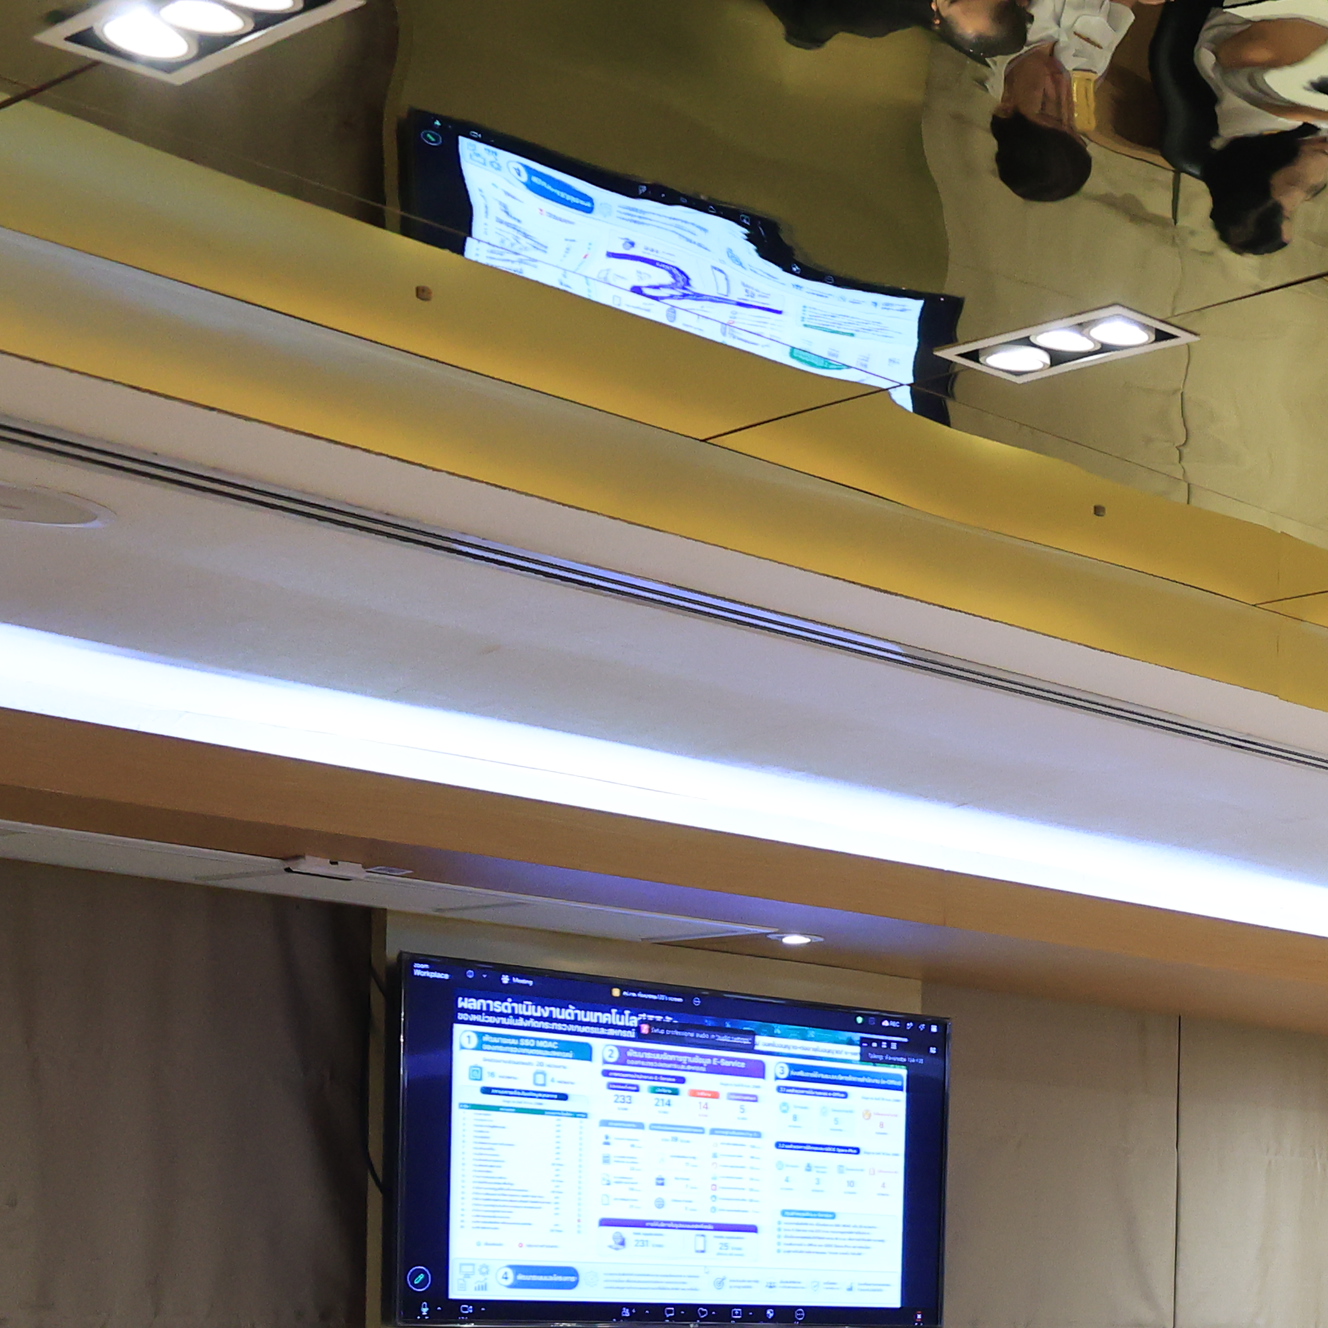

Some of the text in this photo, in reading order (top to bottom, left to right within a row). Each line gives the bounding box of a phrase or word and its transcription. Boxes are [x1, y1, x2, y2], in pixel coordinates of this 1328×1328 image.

[413, 968, 450, 980] Workplace
[536, 1039, 559, 1050] MOAC
[613, 1094, 632, 1104] 233
[654, 1098, 671, 1107] 214
[698, 1101, 709, 1110] 14
[634, 1239, 649, 1248] 231
